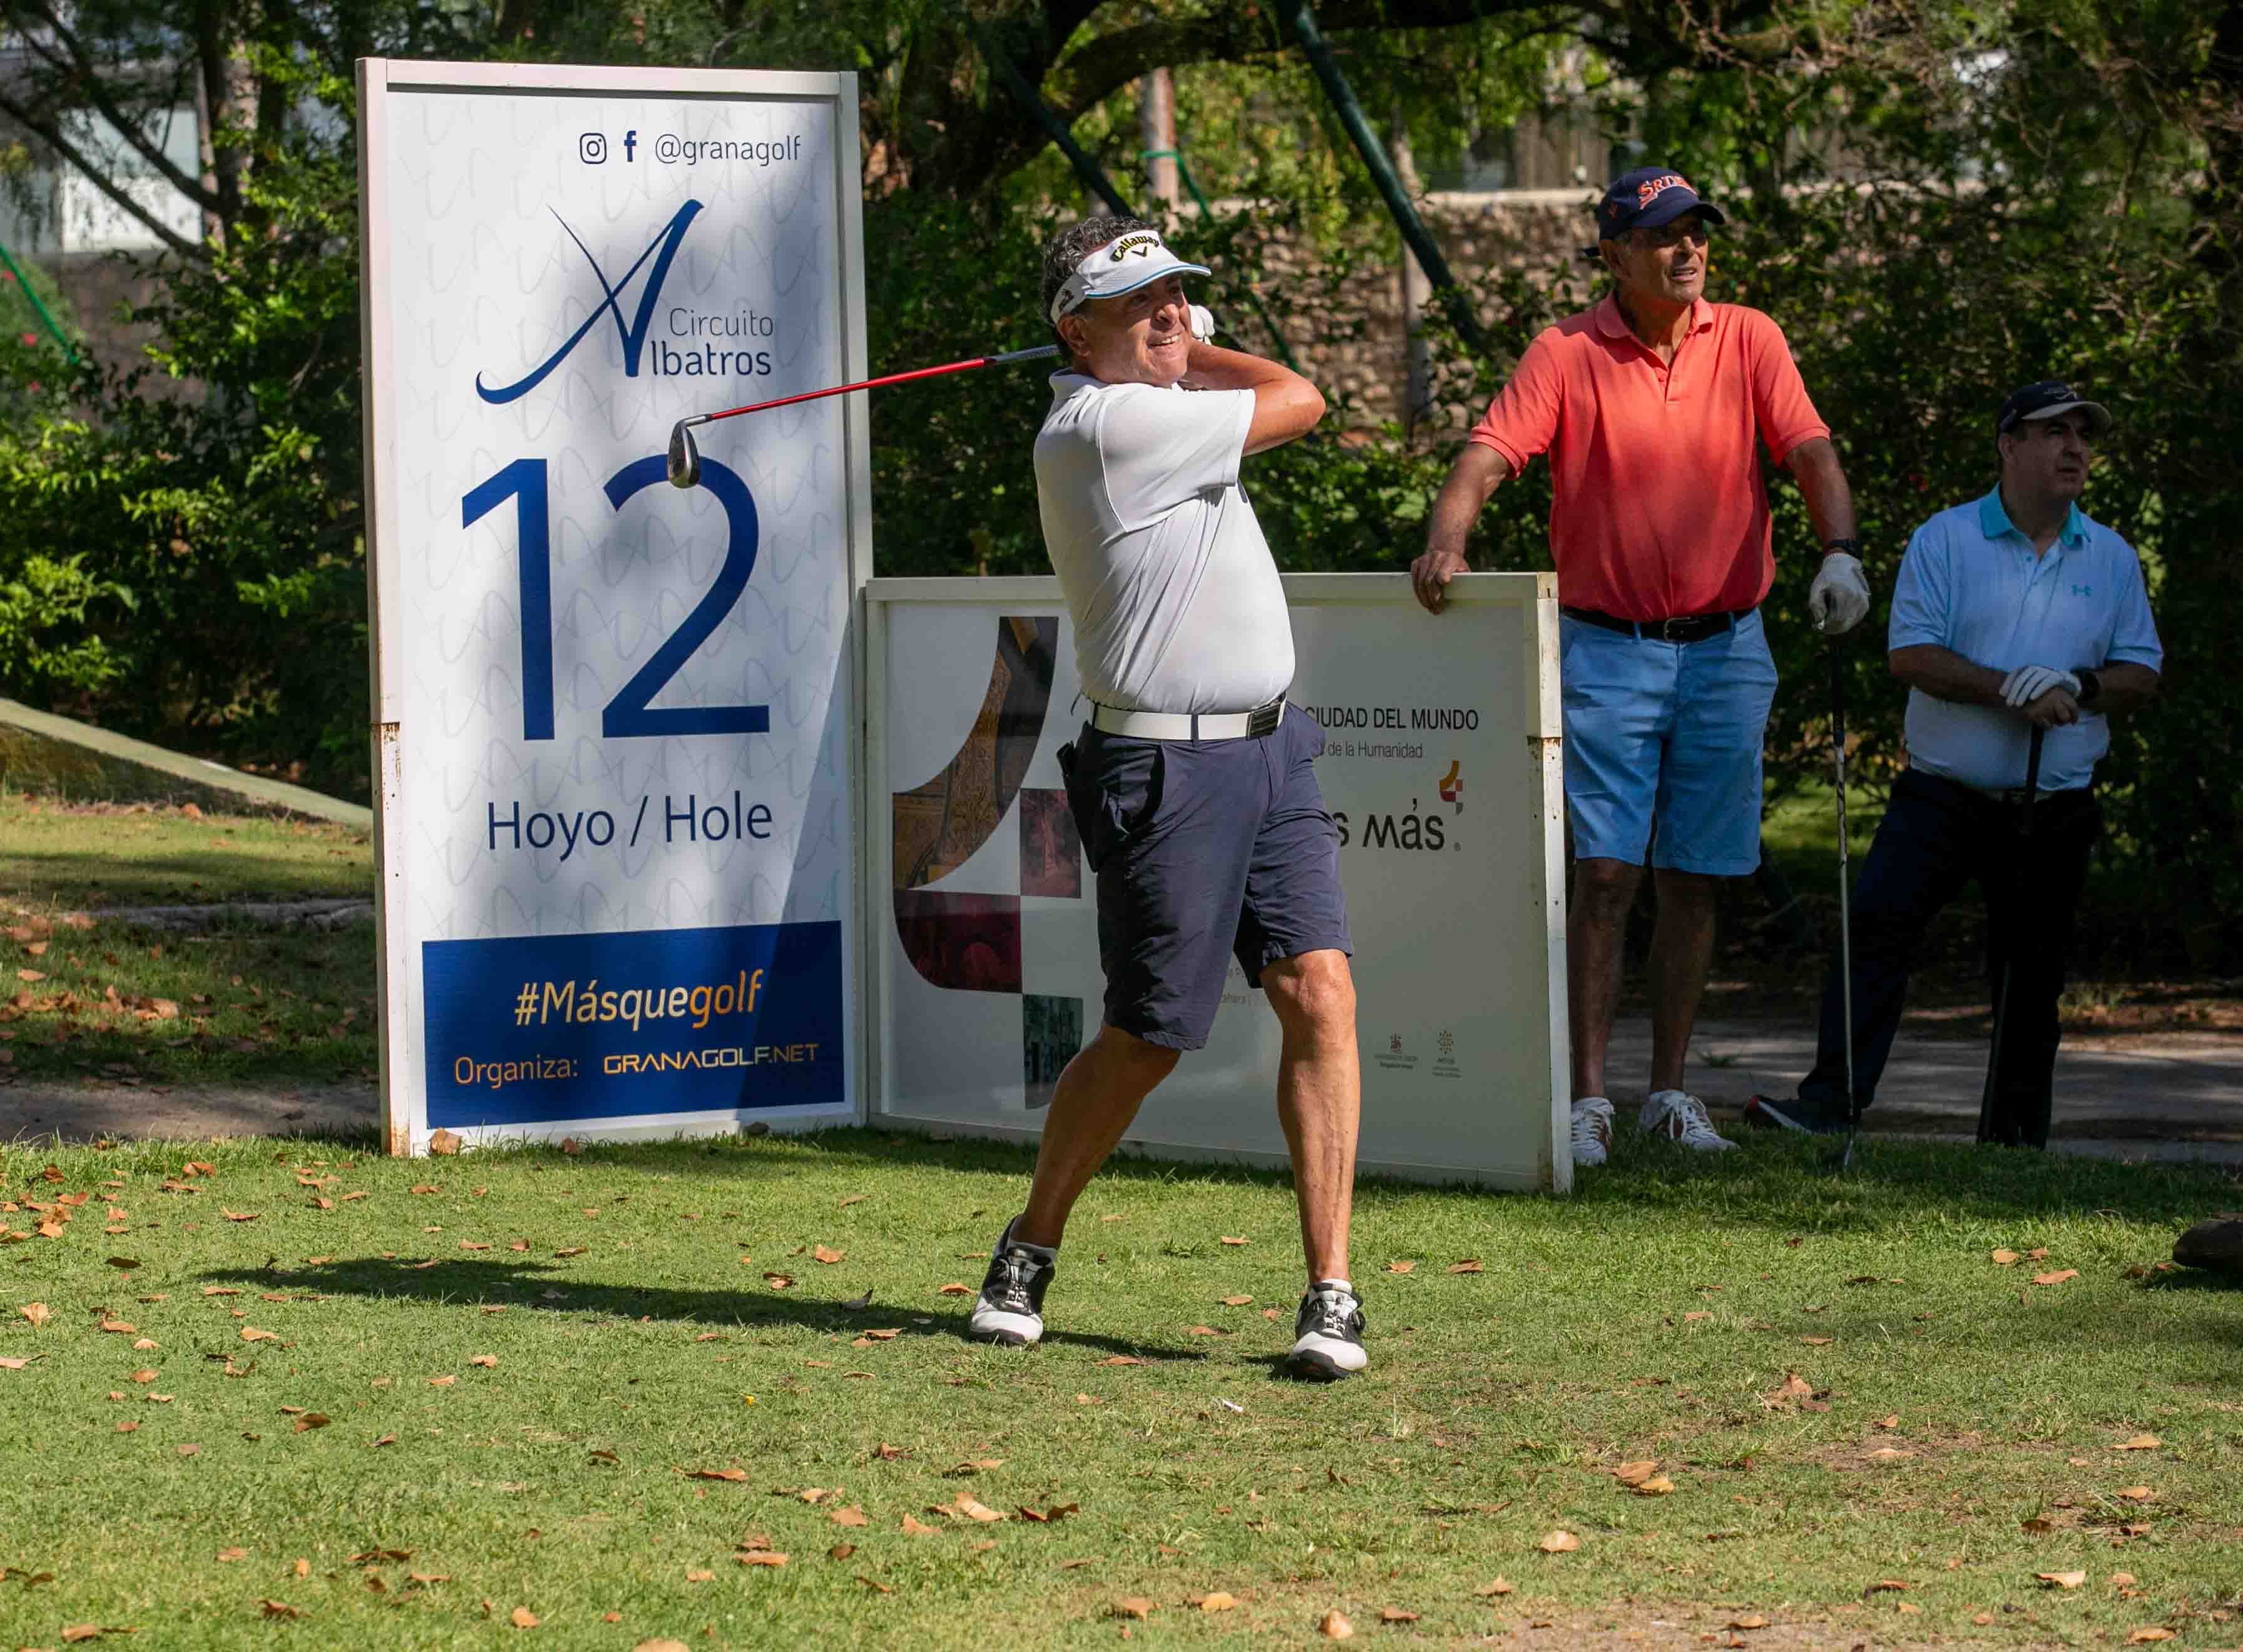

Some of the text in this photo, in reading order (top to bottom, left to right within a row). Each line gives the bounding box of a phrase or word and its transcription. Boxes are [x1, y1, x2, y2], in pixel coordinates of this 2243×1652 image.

[655, 133, 801, 167] @granagolf
[1110, 235, 1160, 262] Callaway
[670, 307, 774, 337] Circuito
[462, 454, 770, 741] 12
[1373, 708, 1407, 729] DEL
[1411, 709, 1479, 730] MUNDO
[1327, 741, 1423, 758] de la Humanidad
[488, 800, 615, 862] Hoyo
[665, 790, 772, 843] Hole
[514, 969, 764, 1032] #Másquegolf
[454, 1054, 579, 1089] Organiza:
